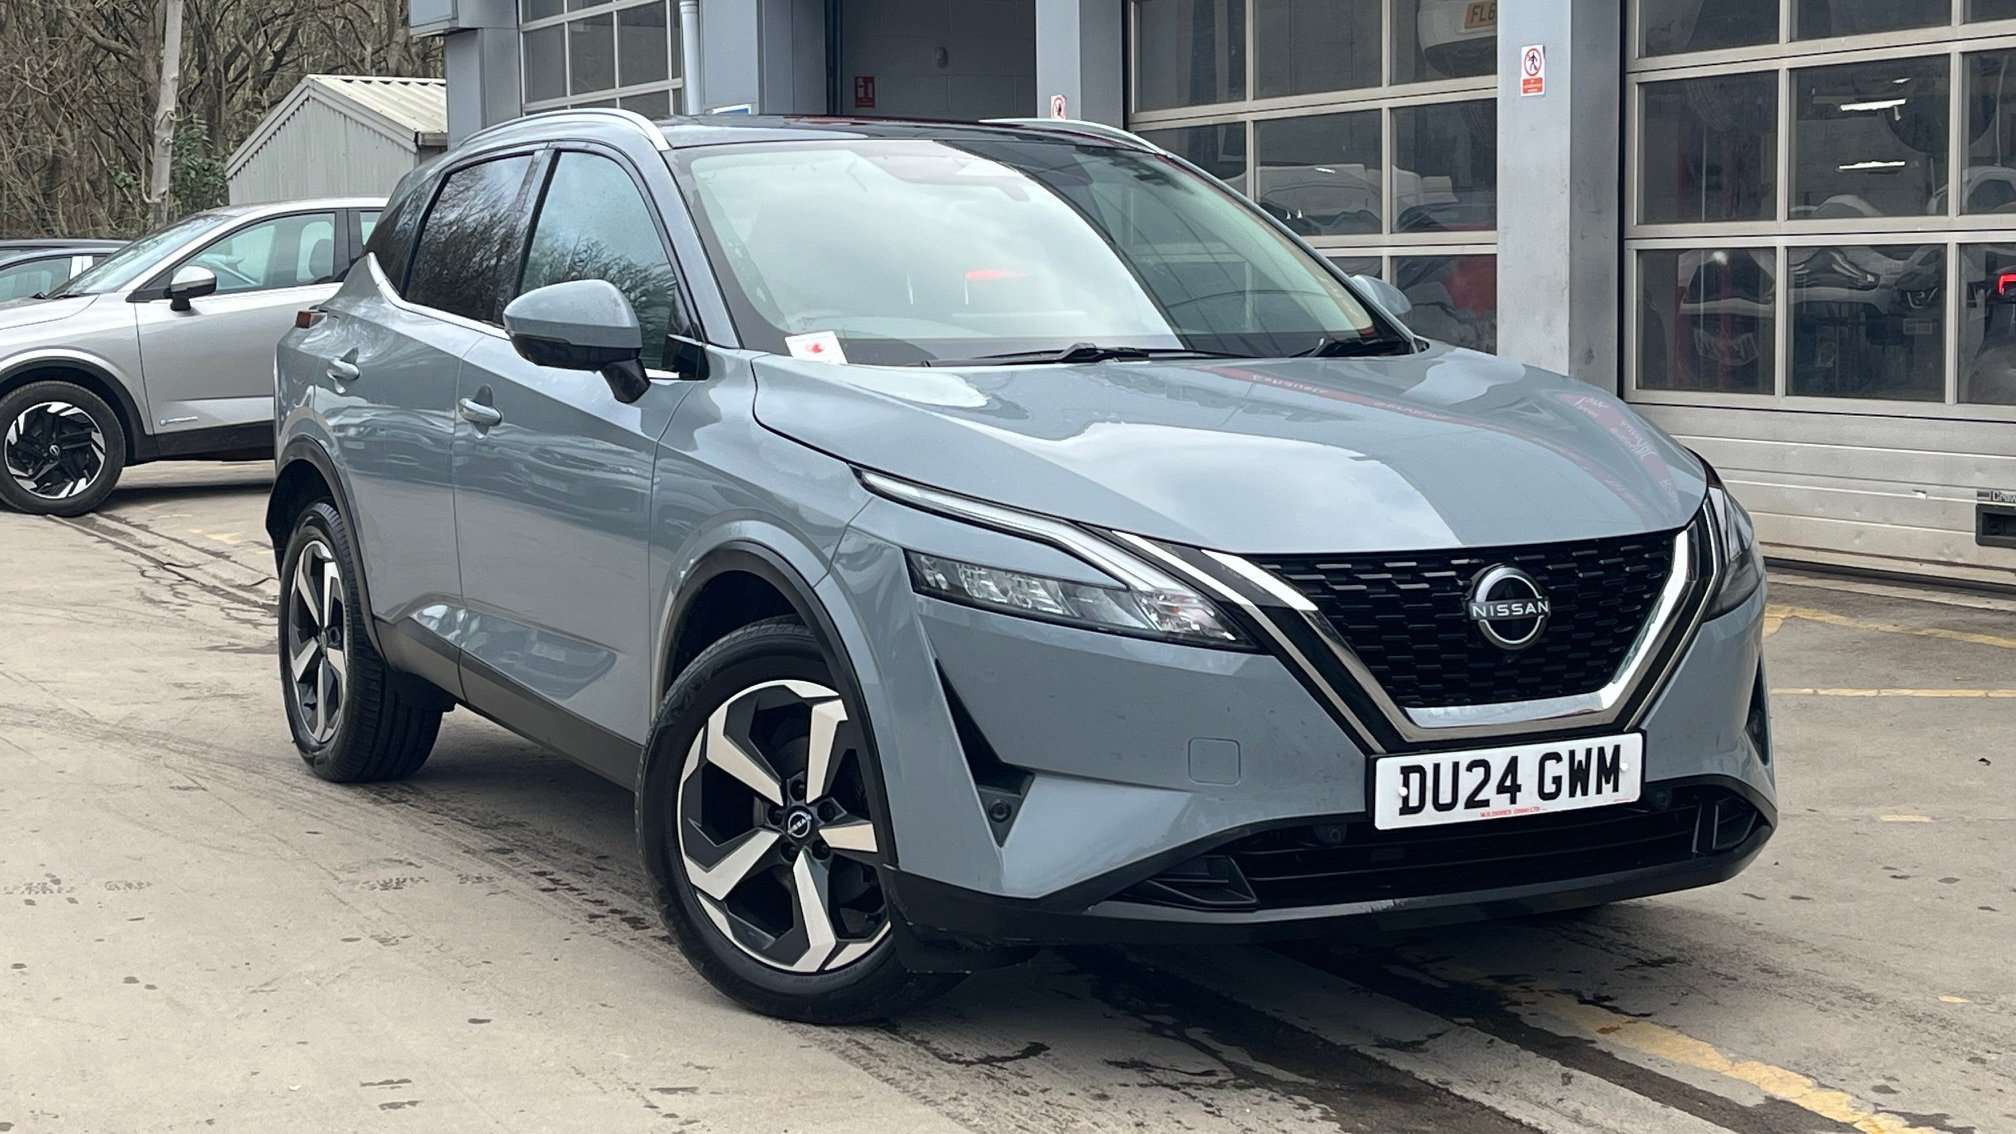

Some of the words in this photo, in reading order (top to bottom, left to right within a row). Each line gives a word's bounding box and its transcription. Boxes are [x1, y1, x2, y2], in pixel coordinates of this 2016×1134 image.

[1472, 600, 1549, 617] NISSAN
[1399, 755, 1522, 816] DU24
[1537, 744, 1621, 801] GWM
